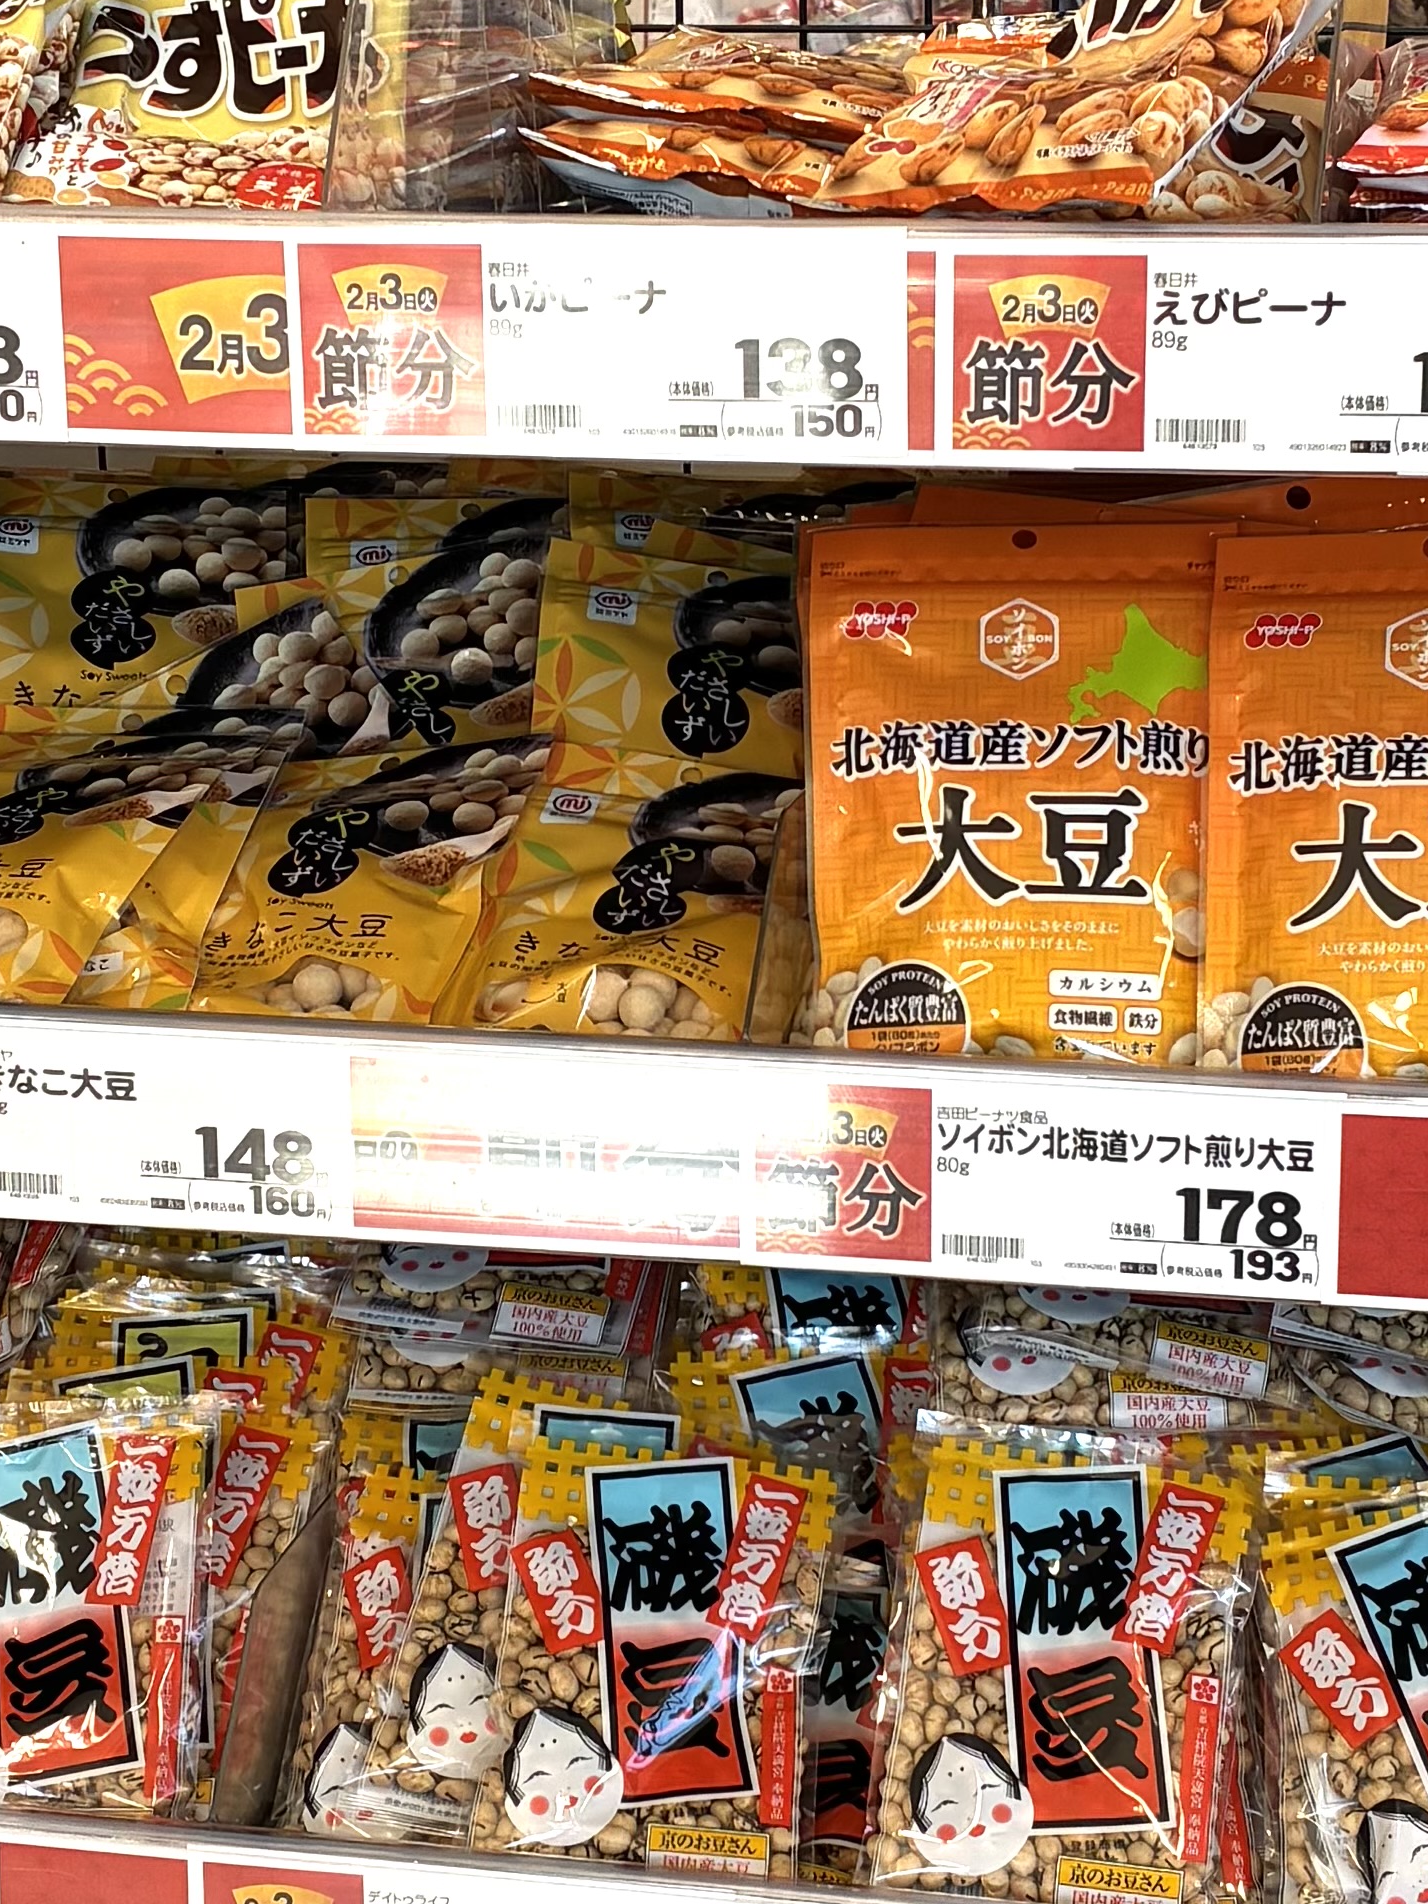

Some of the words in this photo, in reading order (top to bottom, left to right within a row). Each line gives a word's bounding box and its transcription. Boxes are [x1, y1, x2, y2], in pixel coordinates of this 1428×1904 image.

[1152, 289, 1346, 326] えびピーナ
[489, 319, 523, 338] 89g
[1152, 331, 1188, 352] 89g
[315, 326, 480, 411] 節分
[967, 338, 1137, 428] 節分
[896, 787, 1153, 913] 大豆
[1057, 973, 1154, 995] カルシウム
[851, 995, 959, 1025] たんぱく質豊富
[1052, 1007, 1115, 1029] 食物繊維
[1127, 1009, 1159, 1031] 鉄分
[938, 1125, 1315, 1173] ソイボン北海道ソフト煎り大豆
[937, 1156, 970, 1177] 80g
[658, 1830, 757, 1855] 京のお豆さん
